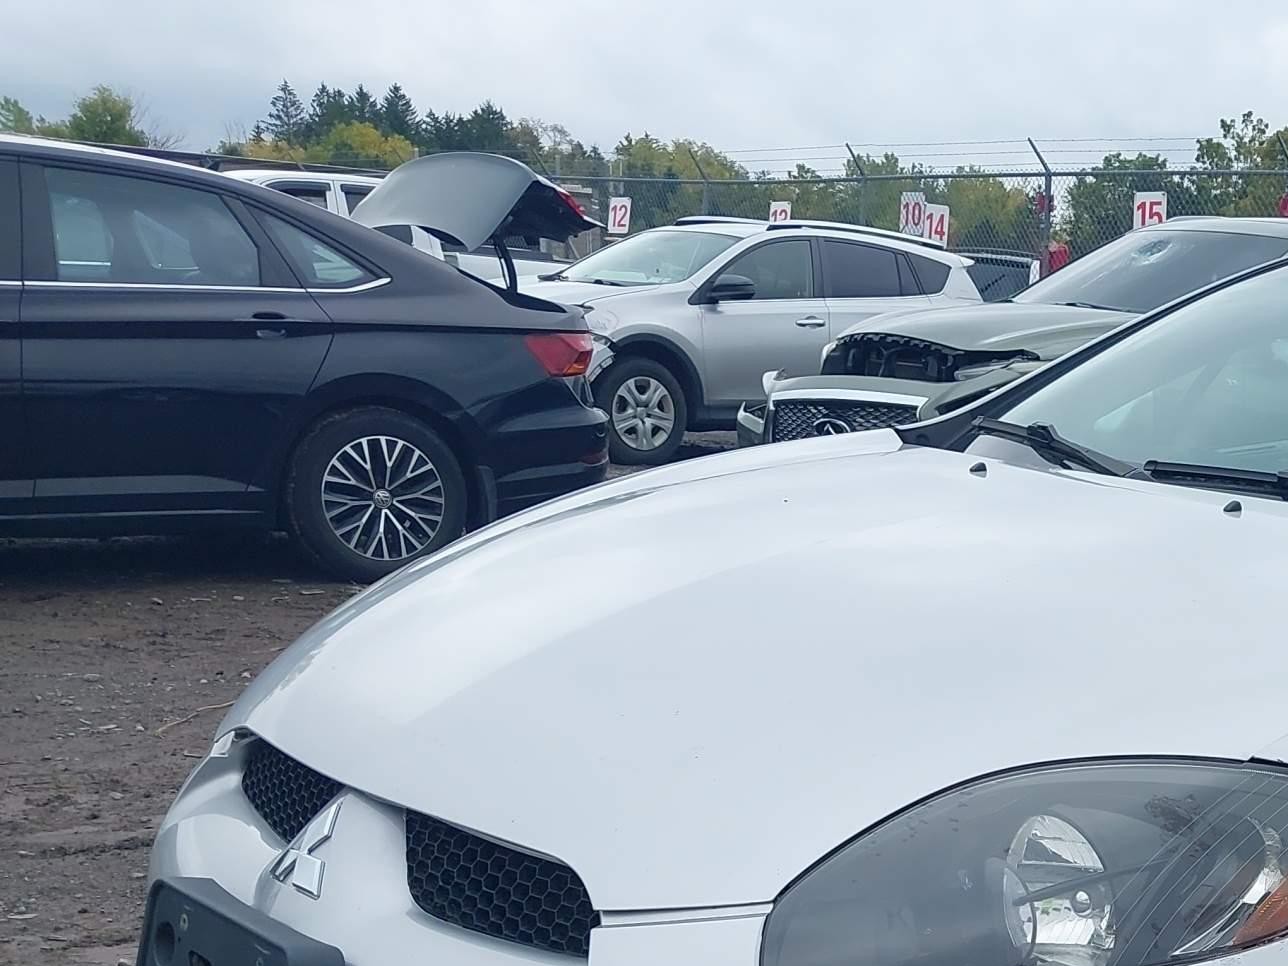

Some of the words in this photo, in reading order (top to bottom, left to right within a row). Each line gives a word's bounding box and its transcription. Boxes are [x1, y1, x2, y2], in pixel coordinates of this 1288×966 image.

[611, 204, 628, 227] 12
[903, 202, 921, 226] 10
[1136, 201, 1163, 226] 15
[926, 212, 945, 241] 14
